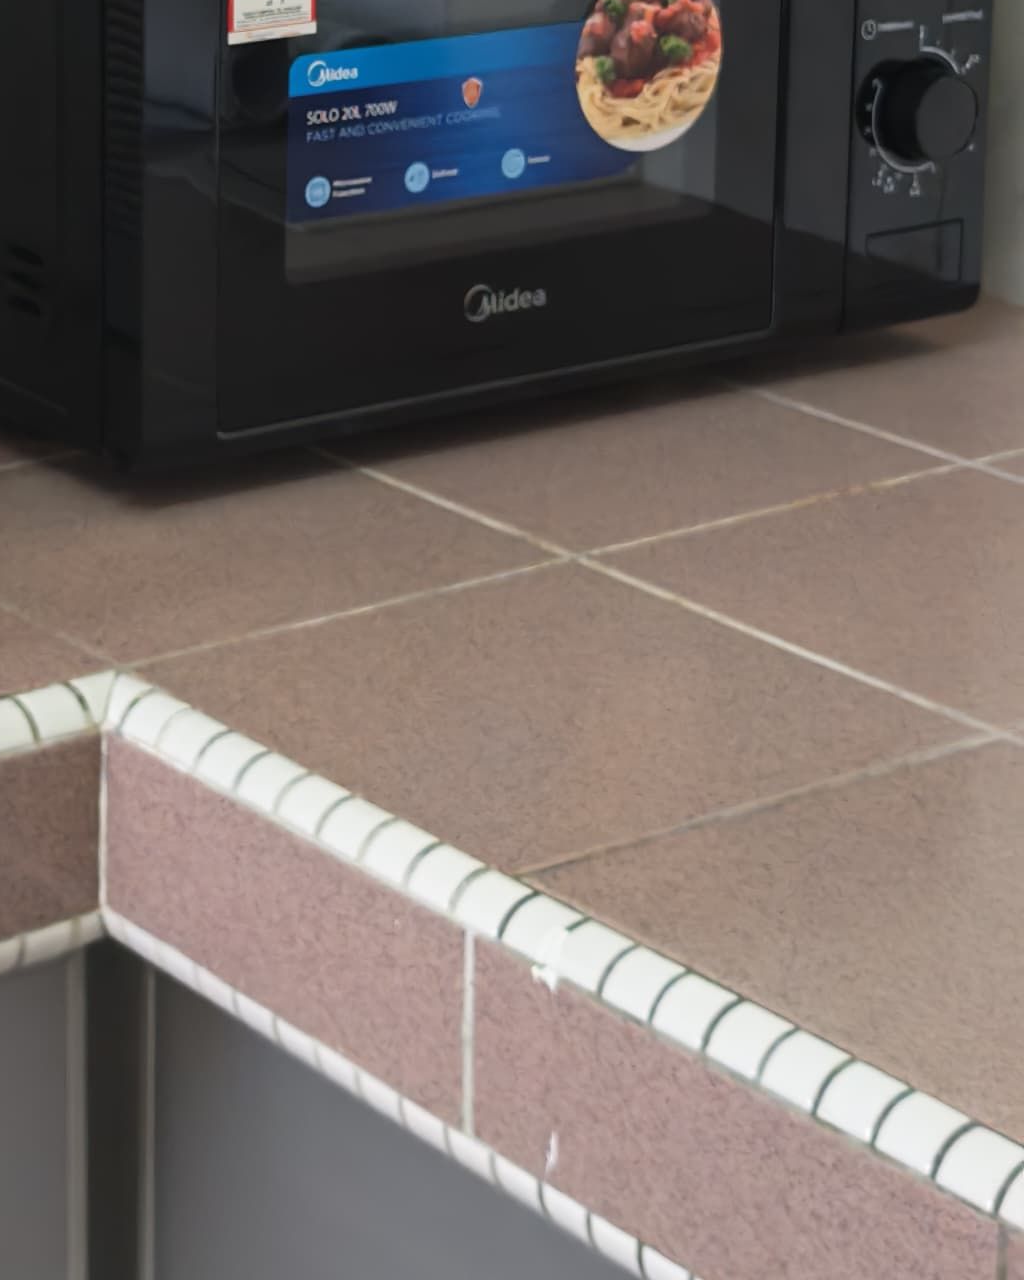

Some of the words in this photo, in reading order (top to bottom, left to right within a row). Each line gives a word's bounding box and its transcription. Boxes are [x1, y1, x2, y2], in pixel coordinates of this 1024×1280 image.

[307, 60, 358, 87] Midea
[306, 108, 339, 126] SOLO
[306, 127, 334, 144] FAST
[339, 122, 364, 139] AND
[368, 115, 442, 135] CONVENIENT
[463, 283, 547, 322] Midea
